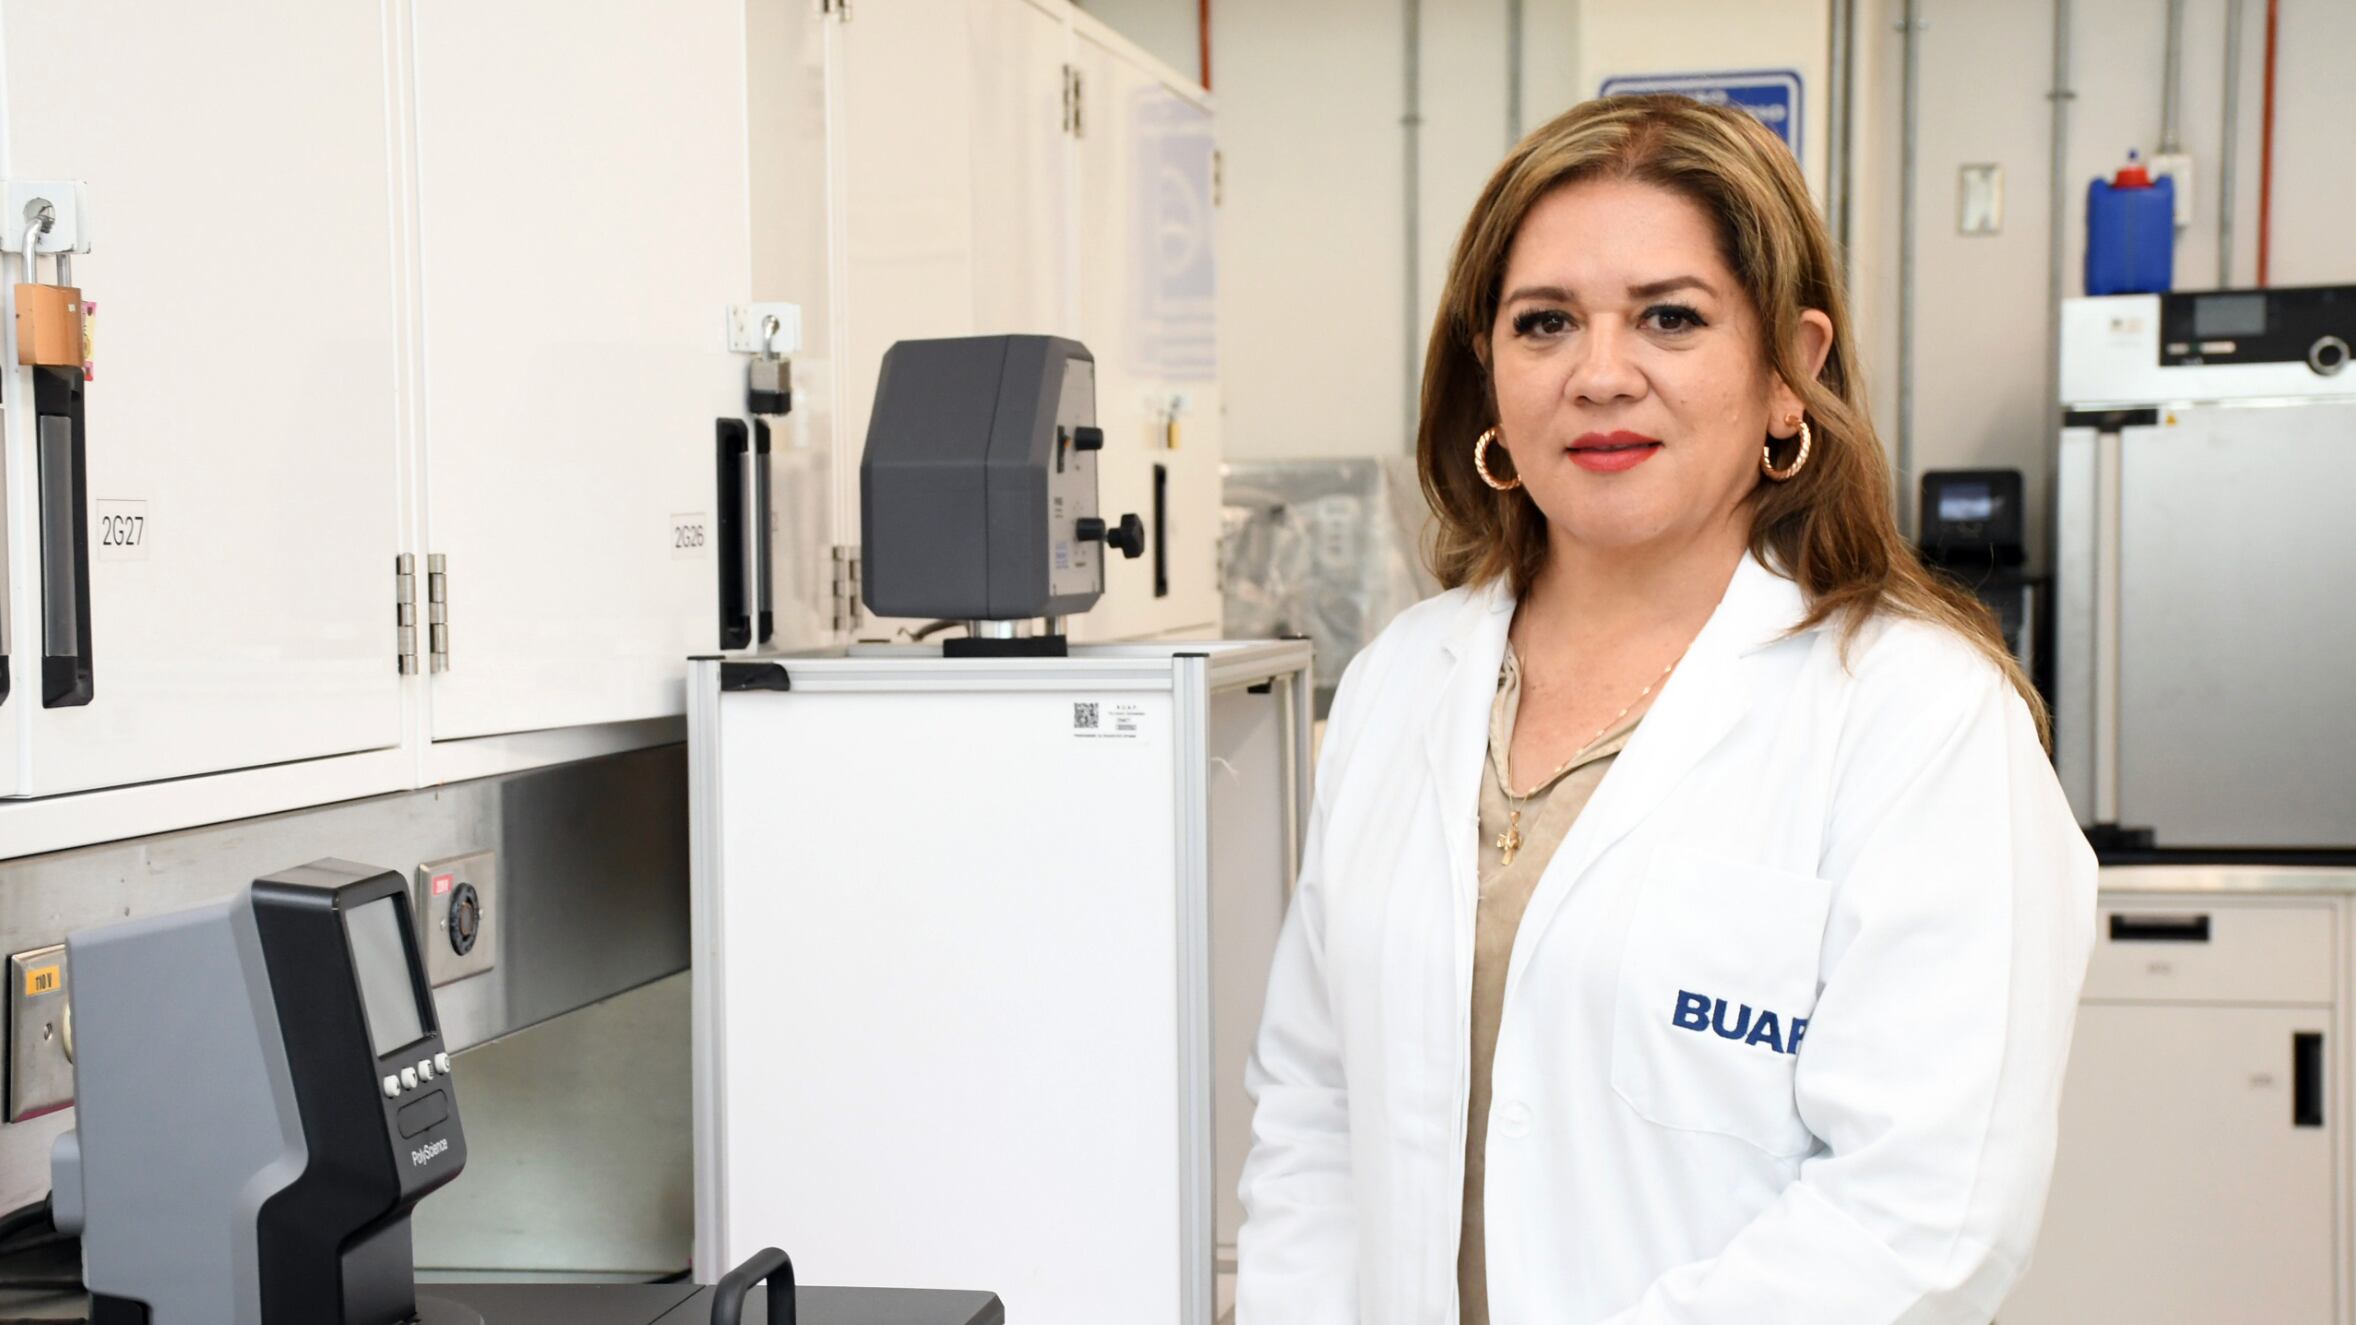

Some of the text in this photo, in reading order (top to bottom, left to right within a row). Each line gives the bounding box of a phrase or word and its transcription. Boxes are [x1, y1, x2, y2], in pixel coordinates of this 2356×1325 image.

[102, 514, 144, 546] 2G27
[675, 524, 705, 548] 2G26
[411, 1138, 448, 1166] PolyScience
